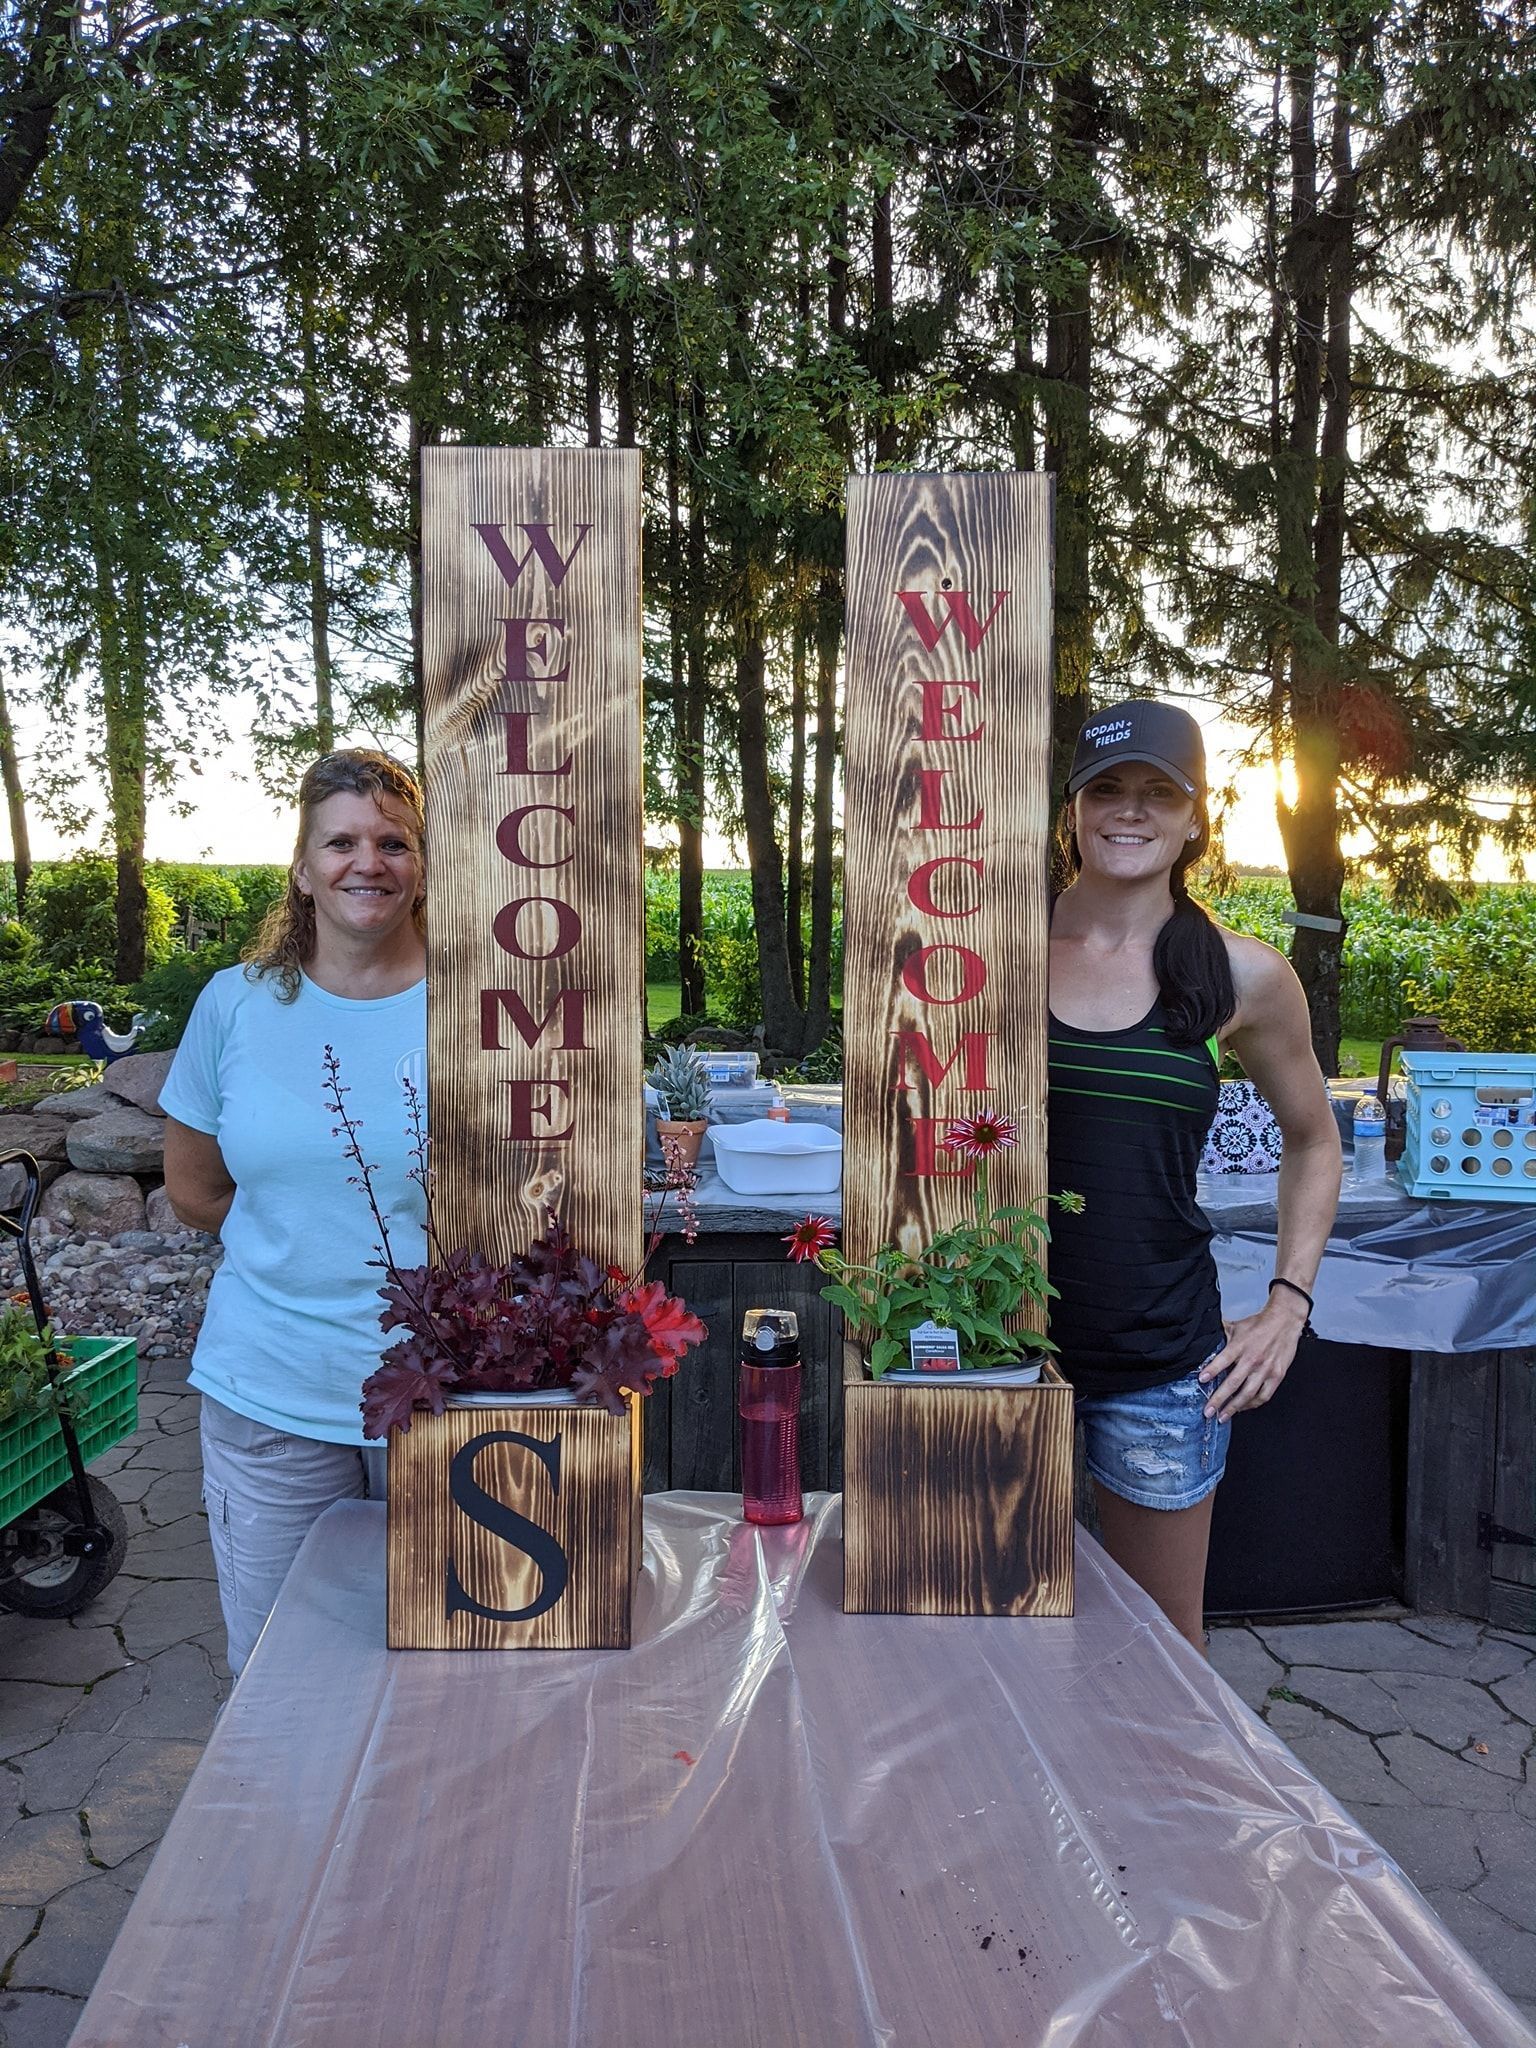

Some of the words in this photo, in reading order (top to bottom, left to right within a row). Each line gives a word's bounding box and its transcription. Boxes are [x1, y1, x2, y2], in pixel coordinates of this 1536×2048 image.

[469, 523, 596, 1141] WELCOME
[889, 591, 1012, 1177] WELCOME
[1095, 730, 1131, 748] FIELDS
[445, 1430, 568, 1622] S
